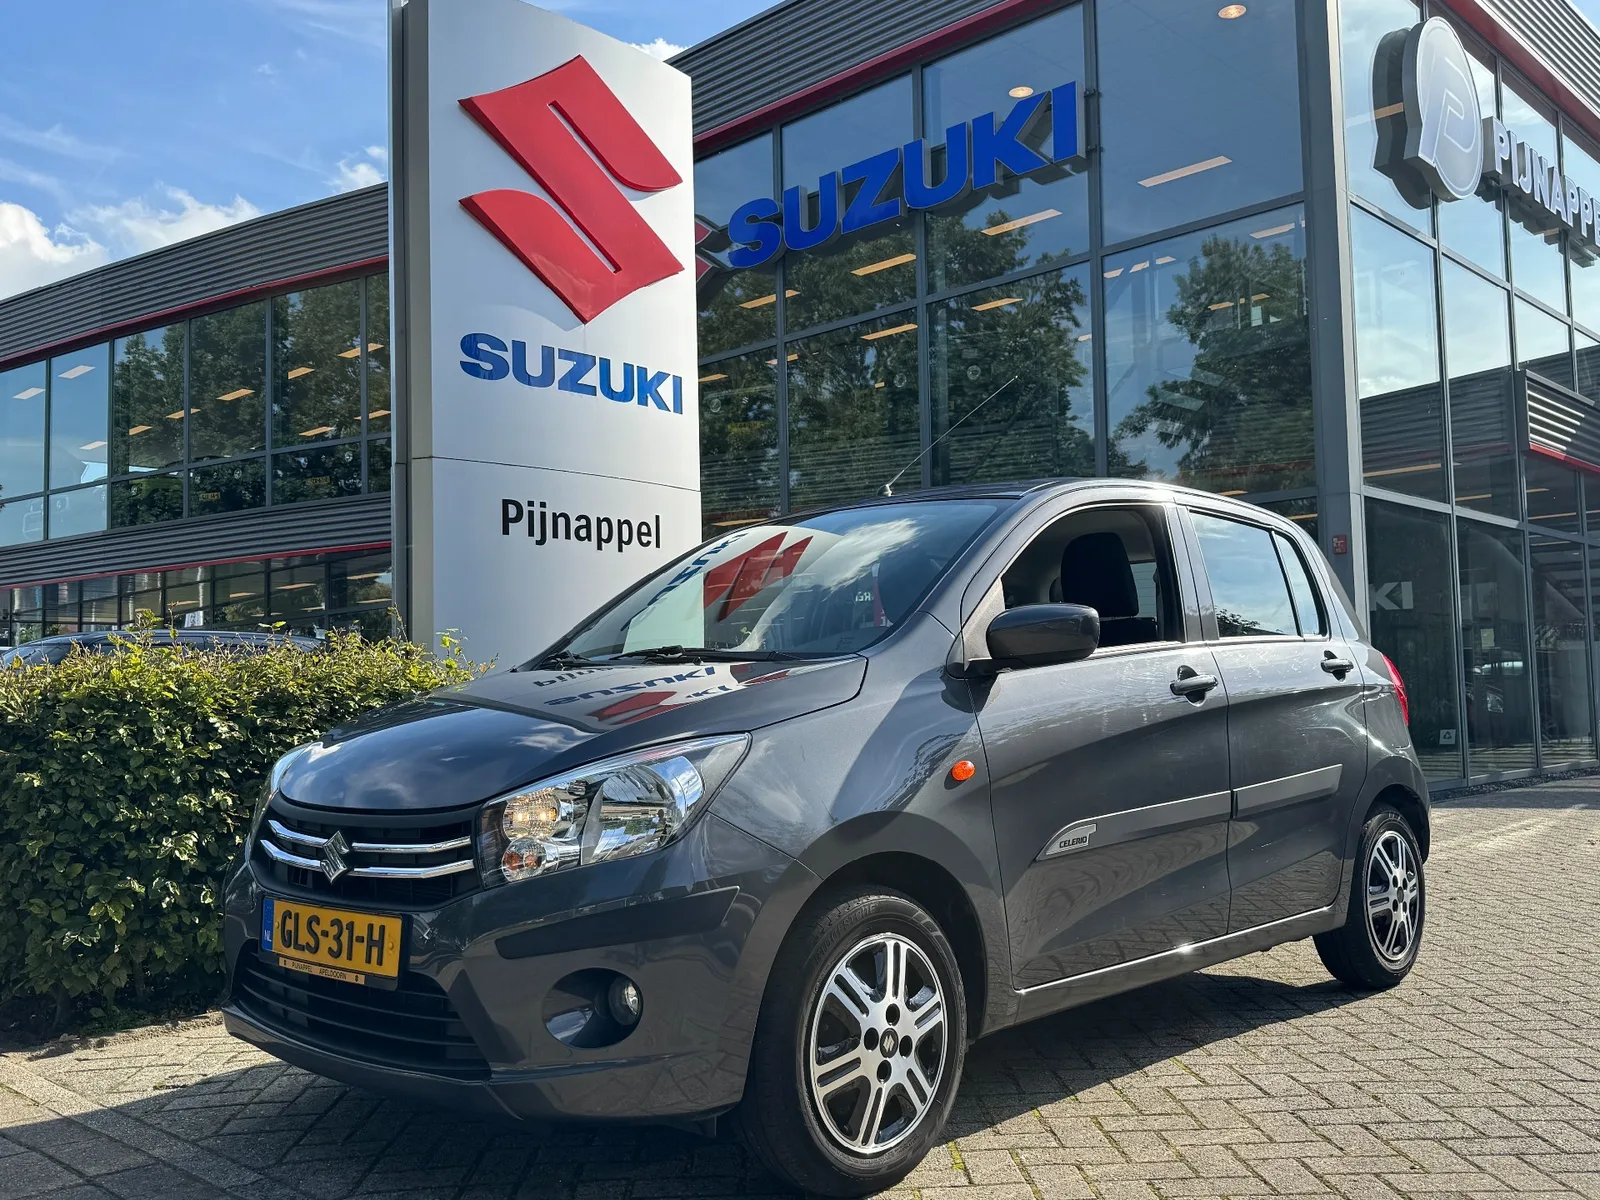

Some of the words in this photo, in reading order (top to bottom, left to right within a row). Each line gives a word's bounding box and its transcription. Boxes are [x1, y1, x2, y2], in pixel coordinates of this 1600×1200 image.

[728, 81, 1080, 269] SUZUKI
[459, 332, 683, 415] SUZUKI
[501, 498, 661, 553] Pijnappel
[1059, 836, 1087, 849] CELERIO
[280, 909, 386, 966] GLS-31-H
[291, 961, 313, 973] PIJNAPPEL
[318, 967, 347, 980] APELDOORN
